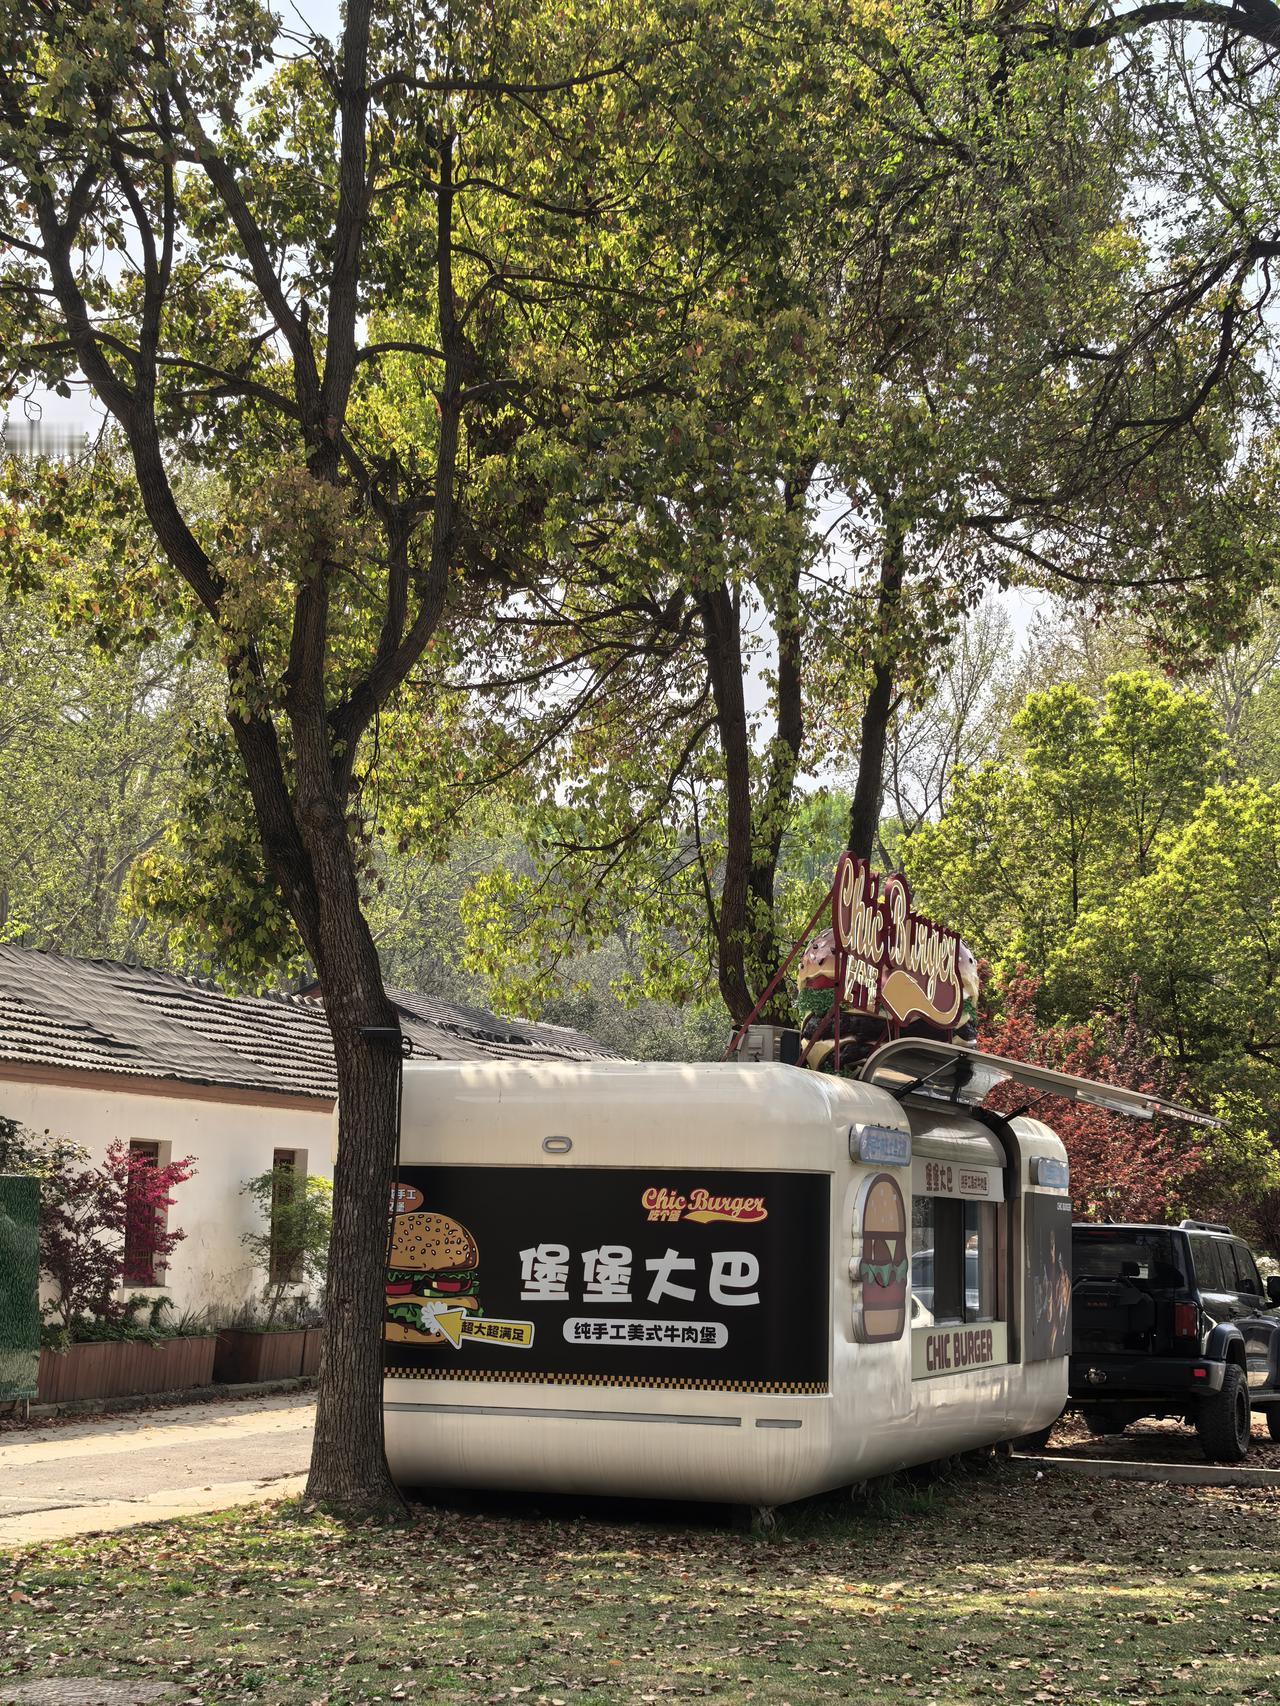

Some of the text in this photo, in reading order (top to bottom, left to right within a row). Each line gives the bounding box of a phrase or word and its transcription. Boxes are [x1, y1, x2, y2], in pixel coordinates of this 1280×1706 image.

[838, 857, 957, 1001] Chic Burger
[925, 1162, 954, 1193] 堡堡大巴
[641, 1187, 767, 1218] Chic Burger
[519, 1243, 761, 1307] 堡堡大巴
[460, 1320, 525, 1342] 超大超满足
[573, 1321, 718, 1345] 纯手工美式牛肉堡
[926, 1328, 993, 1372] CHIC BURGER
